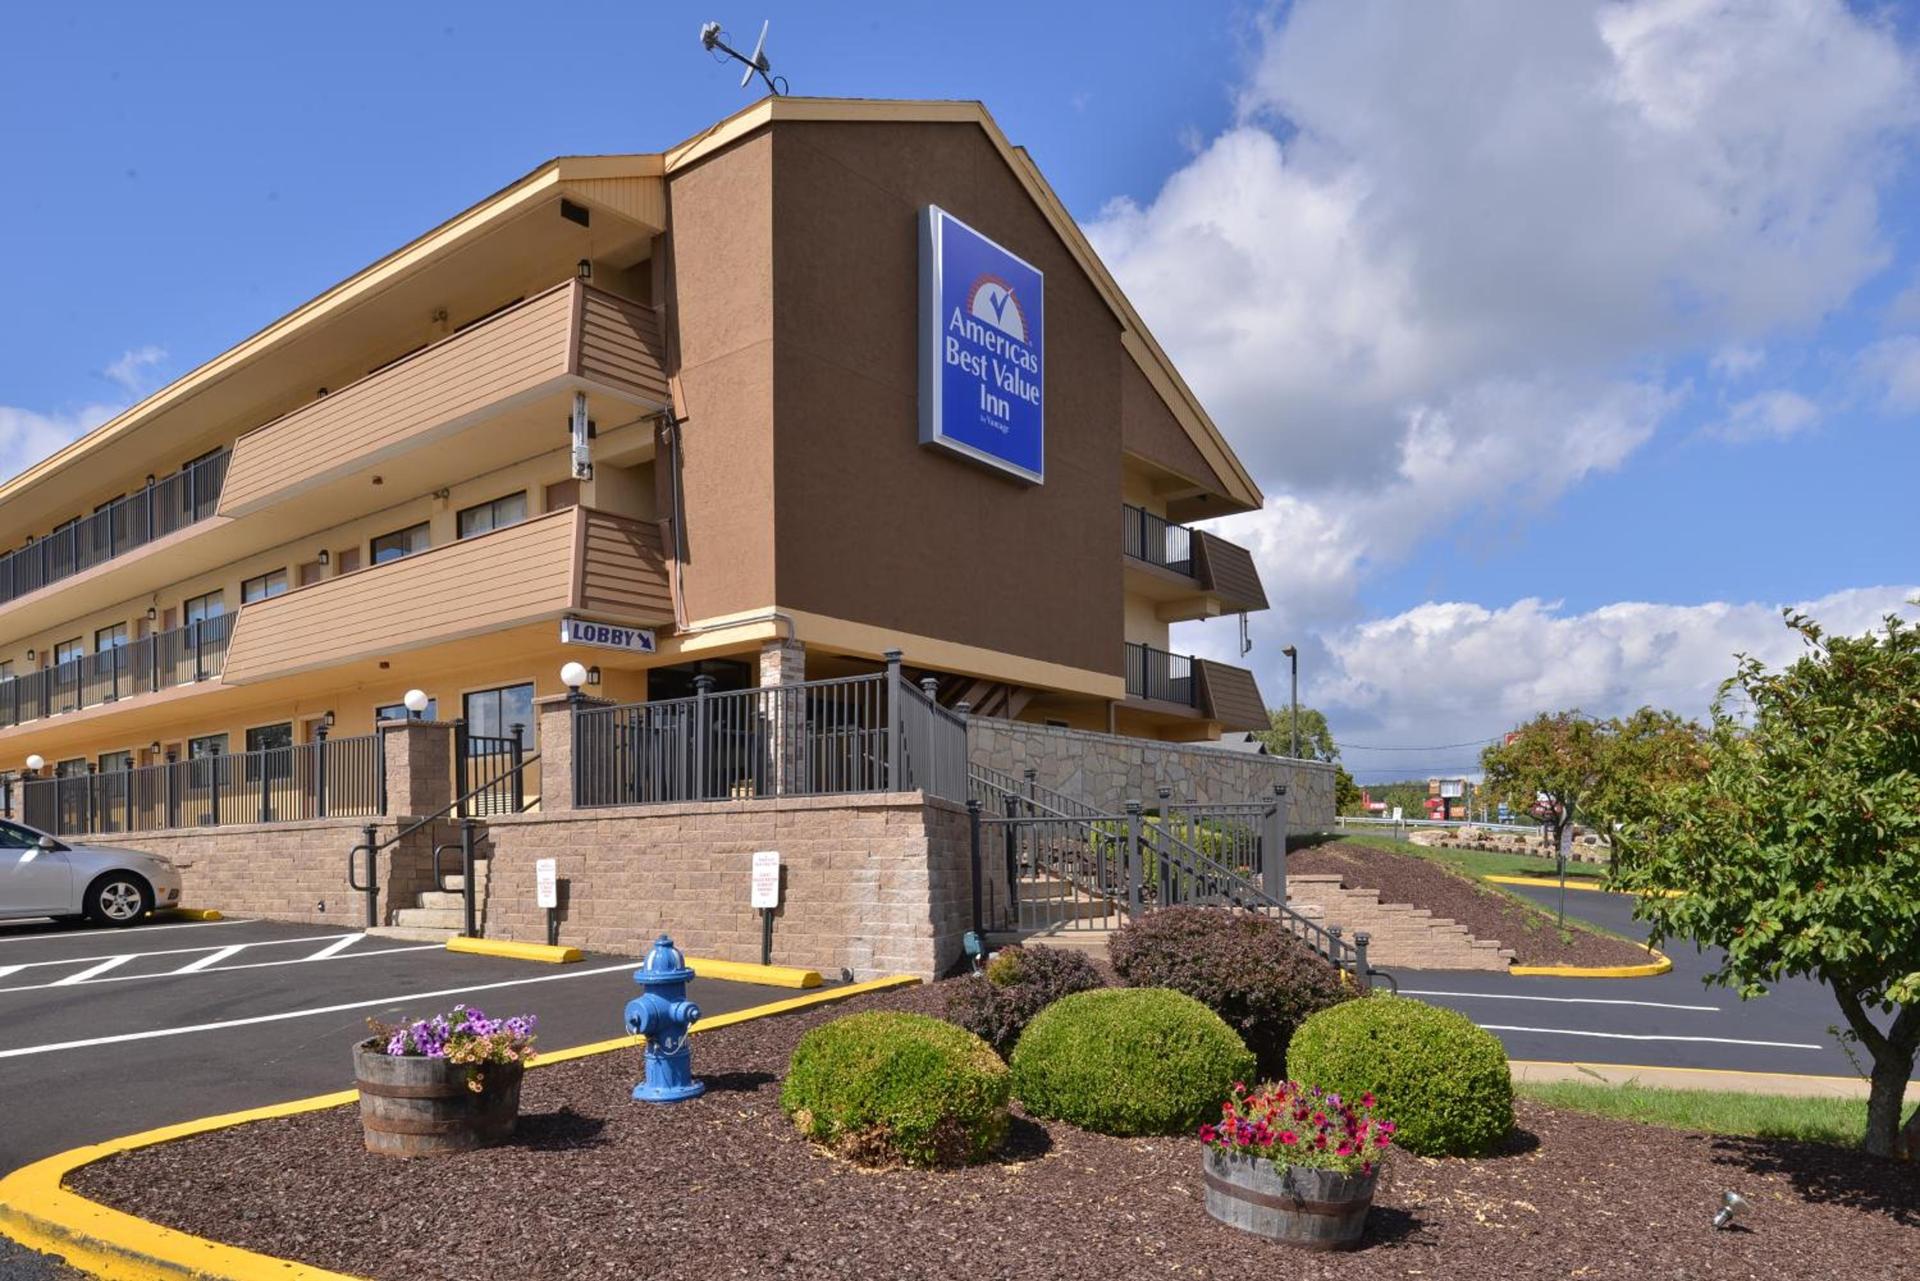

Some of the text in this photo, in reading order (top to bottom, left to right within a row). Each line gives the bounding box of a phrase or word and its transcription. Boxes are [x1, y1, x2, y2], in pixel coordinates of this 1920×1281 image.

[949, 306, 1038, 374] Americas
[946, 335, 1040, 406] Best Value
[981, 383, 1009, 421] Inn
[573, 623, 635, 647] LOBBY
